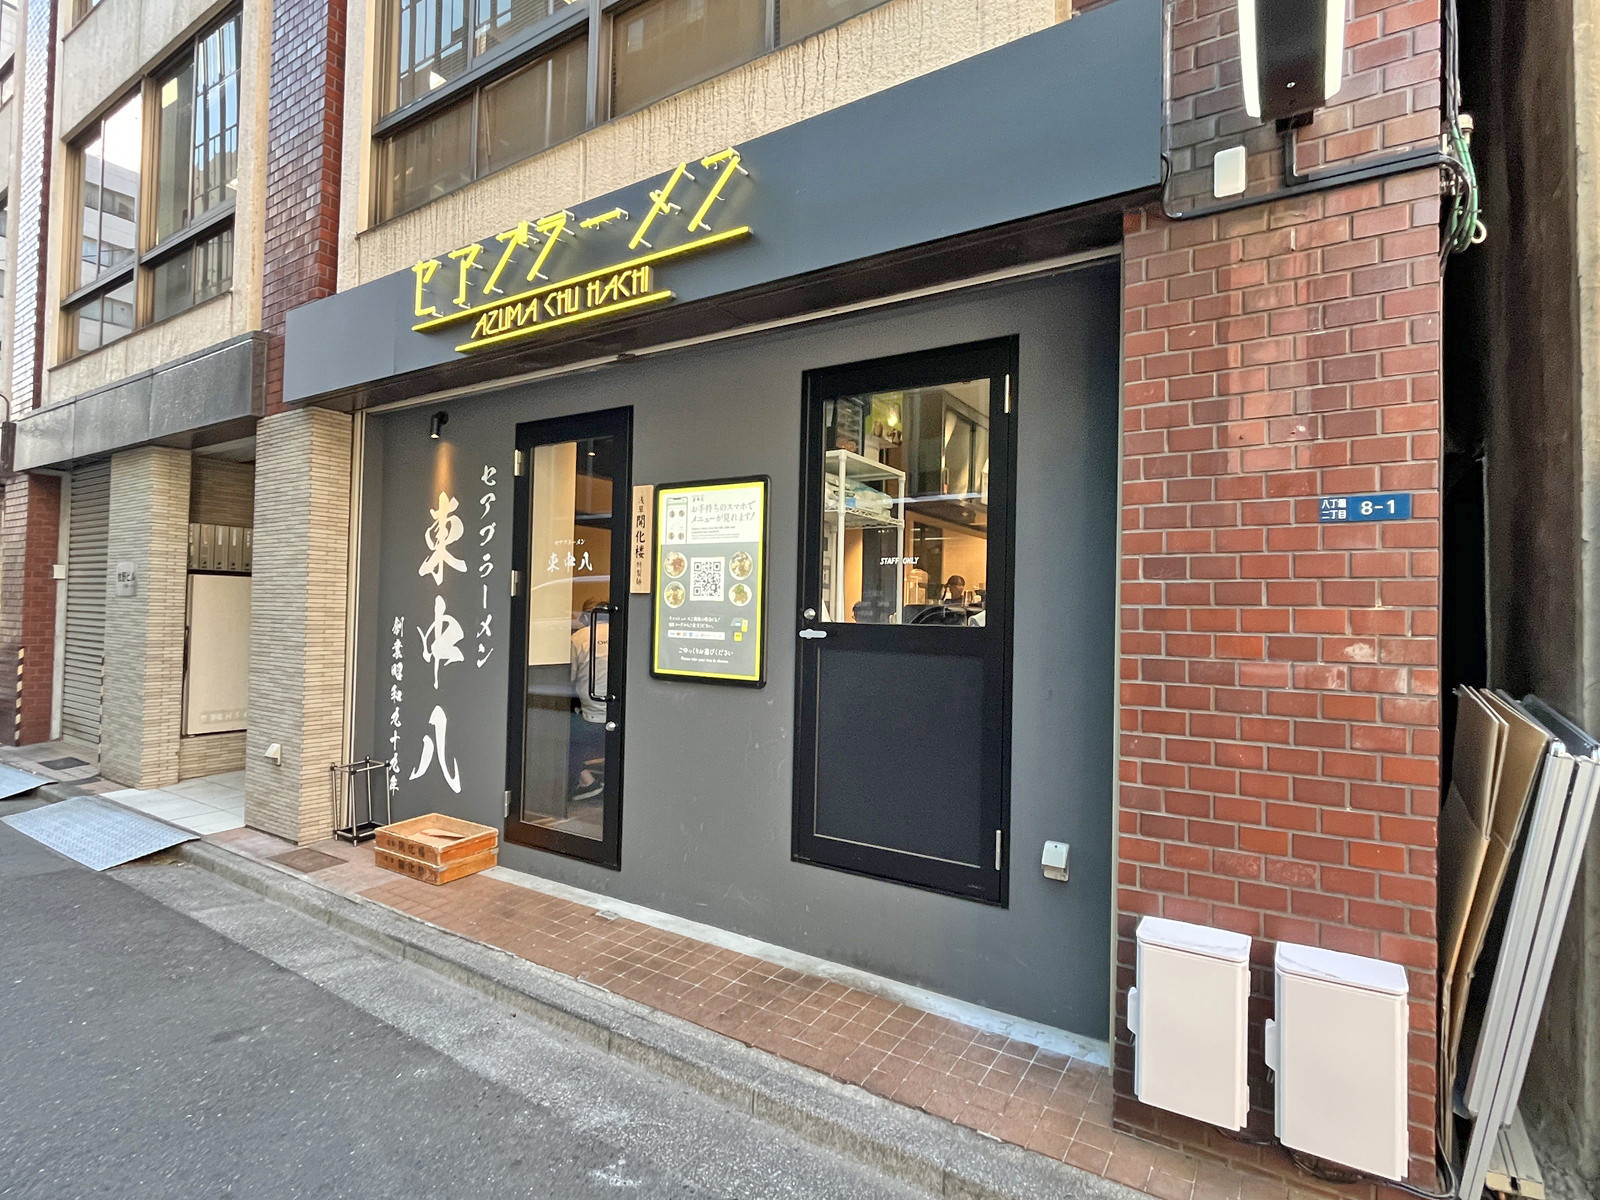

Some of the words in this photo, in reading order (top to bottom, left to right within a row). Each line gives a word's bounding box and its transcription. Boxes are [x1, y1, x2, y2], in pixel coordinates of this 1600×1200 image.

[471, 298, 539, 340] AZUMA
[543, 285, 580, 318] CHU
[586, 265, 651, 308] HACHI
[1321, 509, 1347, 520] 二丁目
[1360, 499, 1395, 515] 8-1
[476, 464, 497, 669] セアブラーメン
[880, 557, 899, 565] STAFF
[902, 556, 919, 565] ONLY
[409, 491, 467, 795] 東中八
